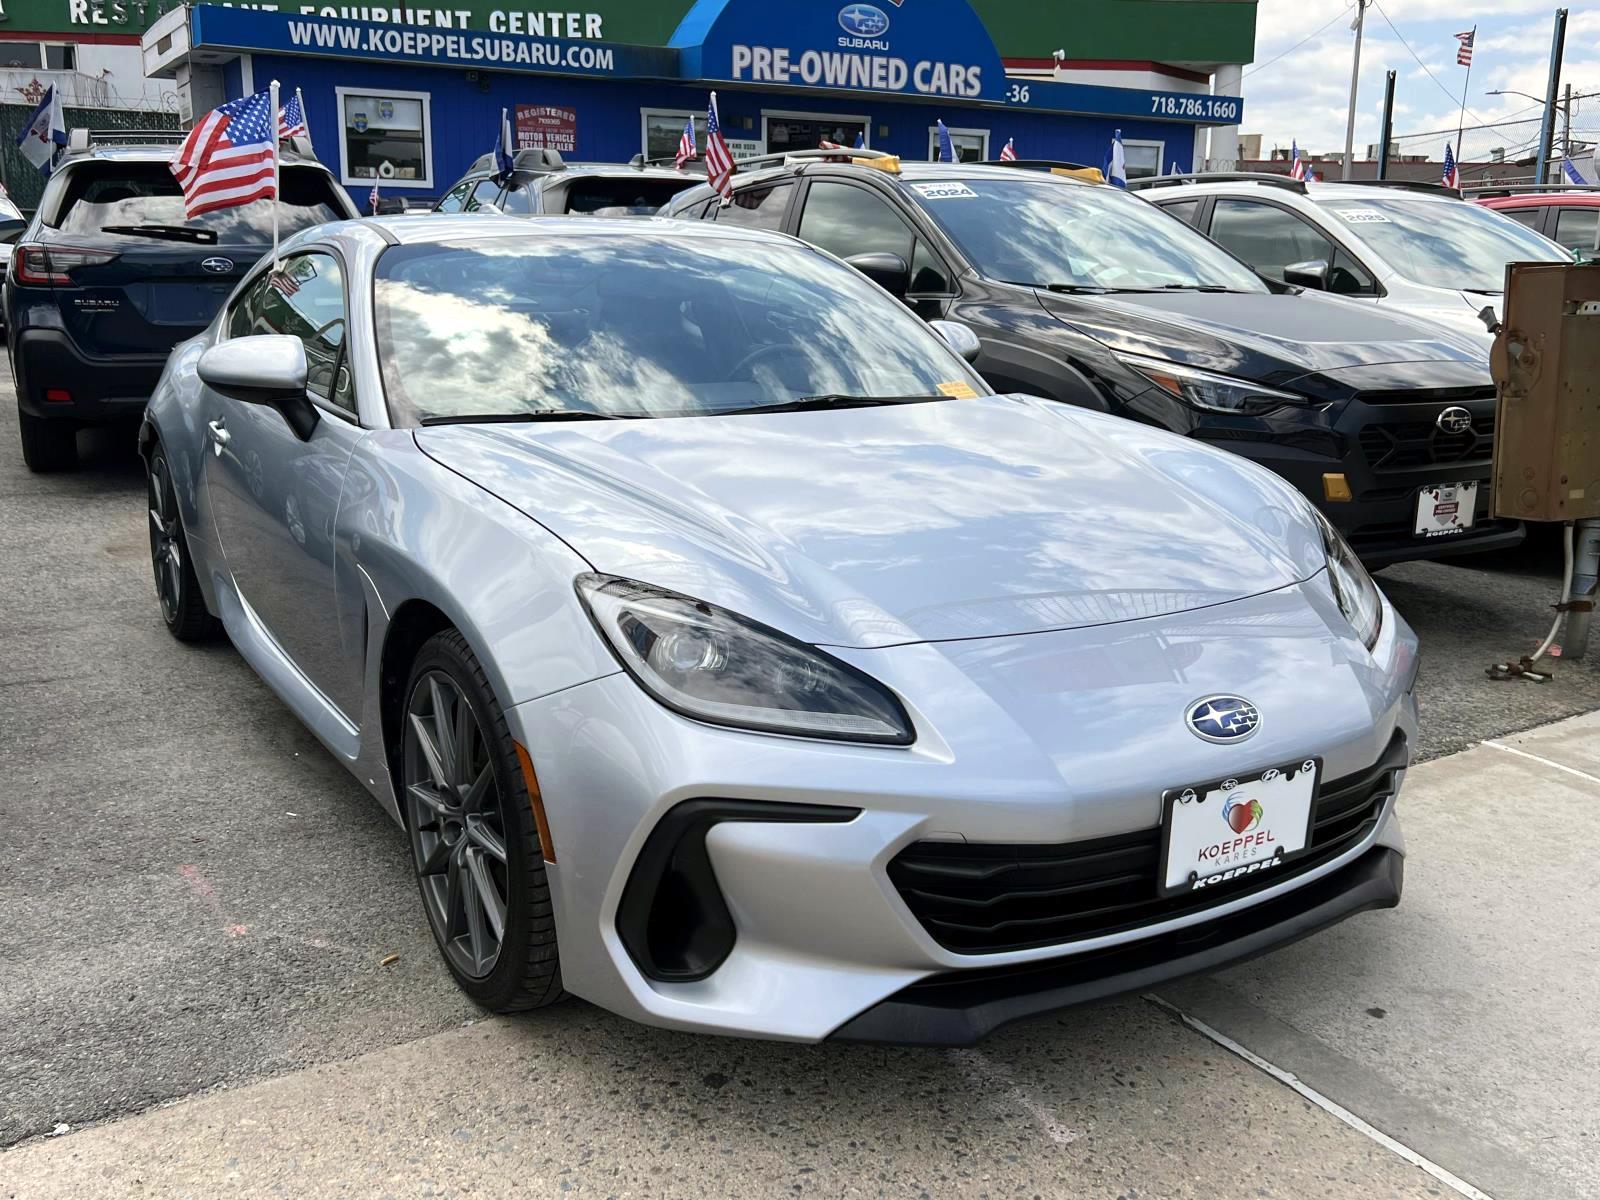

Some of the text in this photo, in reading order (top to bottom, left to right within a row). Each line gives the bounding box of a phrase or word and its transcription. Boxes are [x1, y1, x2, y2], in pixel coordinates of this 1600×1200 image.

[489, 10, 602, 38] CENTER
[288, 21, 614, 70] WWW.KOEPPELSUBARU.COM
[838, 37, 889, 50] SUBARU
[732, 45, 981, 96] PRE-OWNED CARS
[517, 107, 576, 122] REGISTERED
[1151, 96, 1237, 119] 718.786.1660
[518, 132, 575, 143] MOTOR VEHICLE
[520, 141, 573, 152] RETAIL DEALER
[923, 189, 973, 197] 2024
[1426, 528, 1463, 537] KOEPPEL
[1198, 830, 1275, 862] KOEPPEL
[1214, 847, 1257, 867] KARES
[1192, 857, 1281, 890] KOEPPEL
